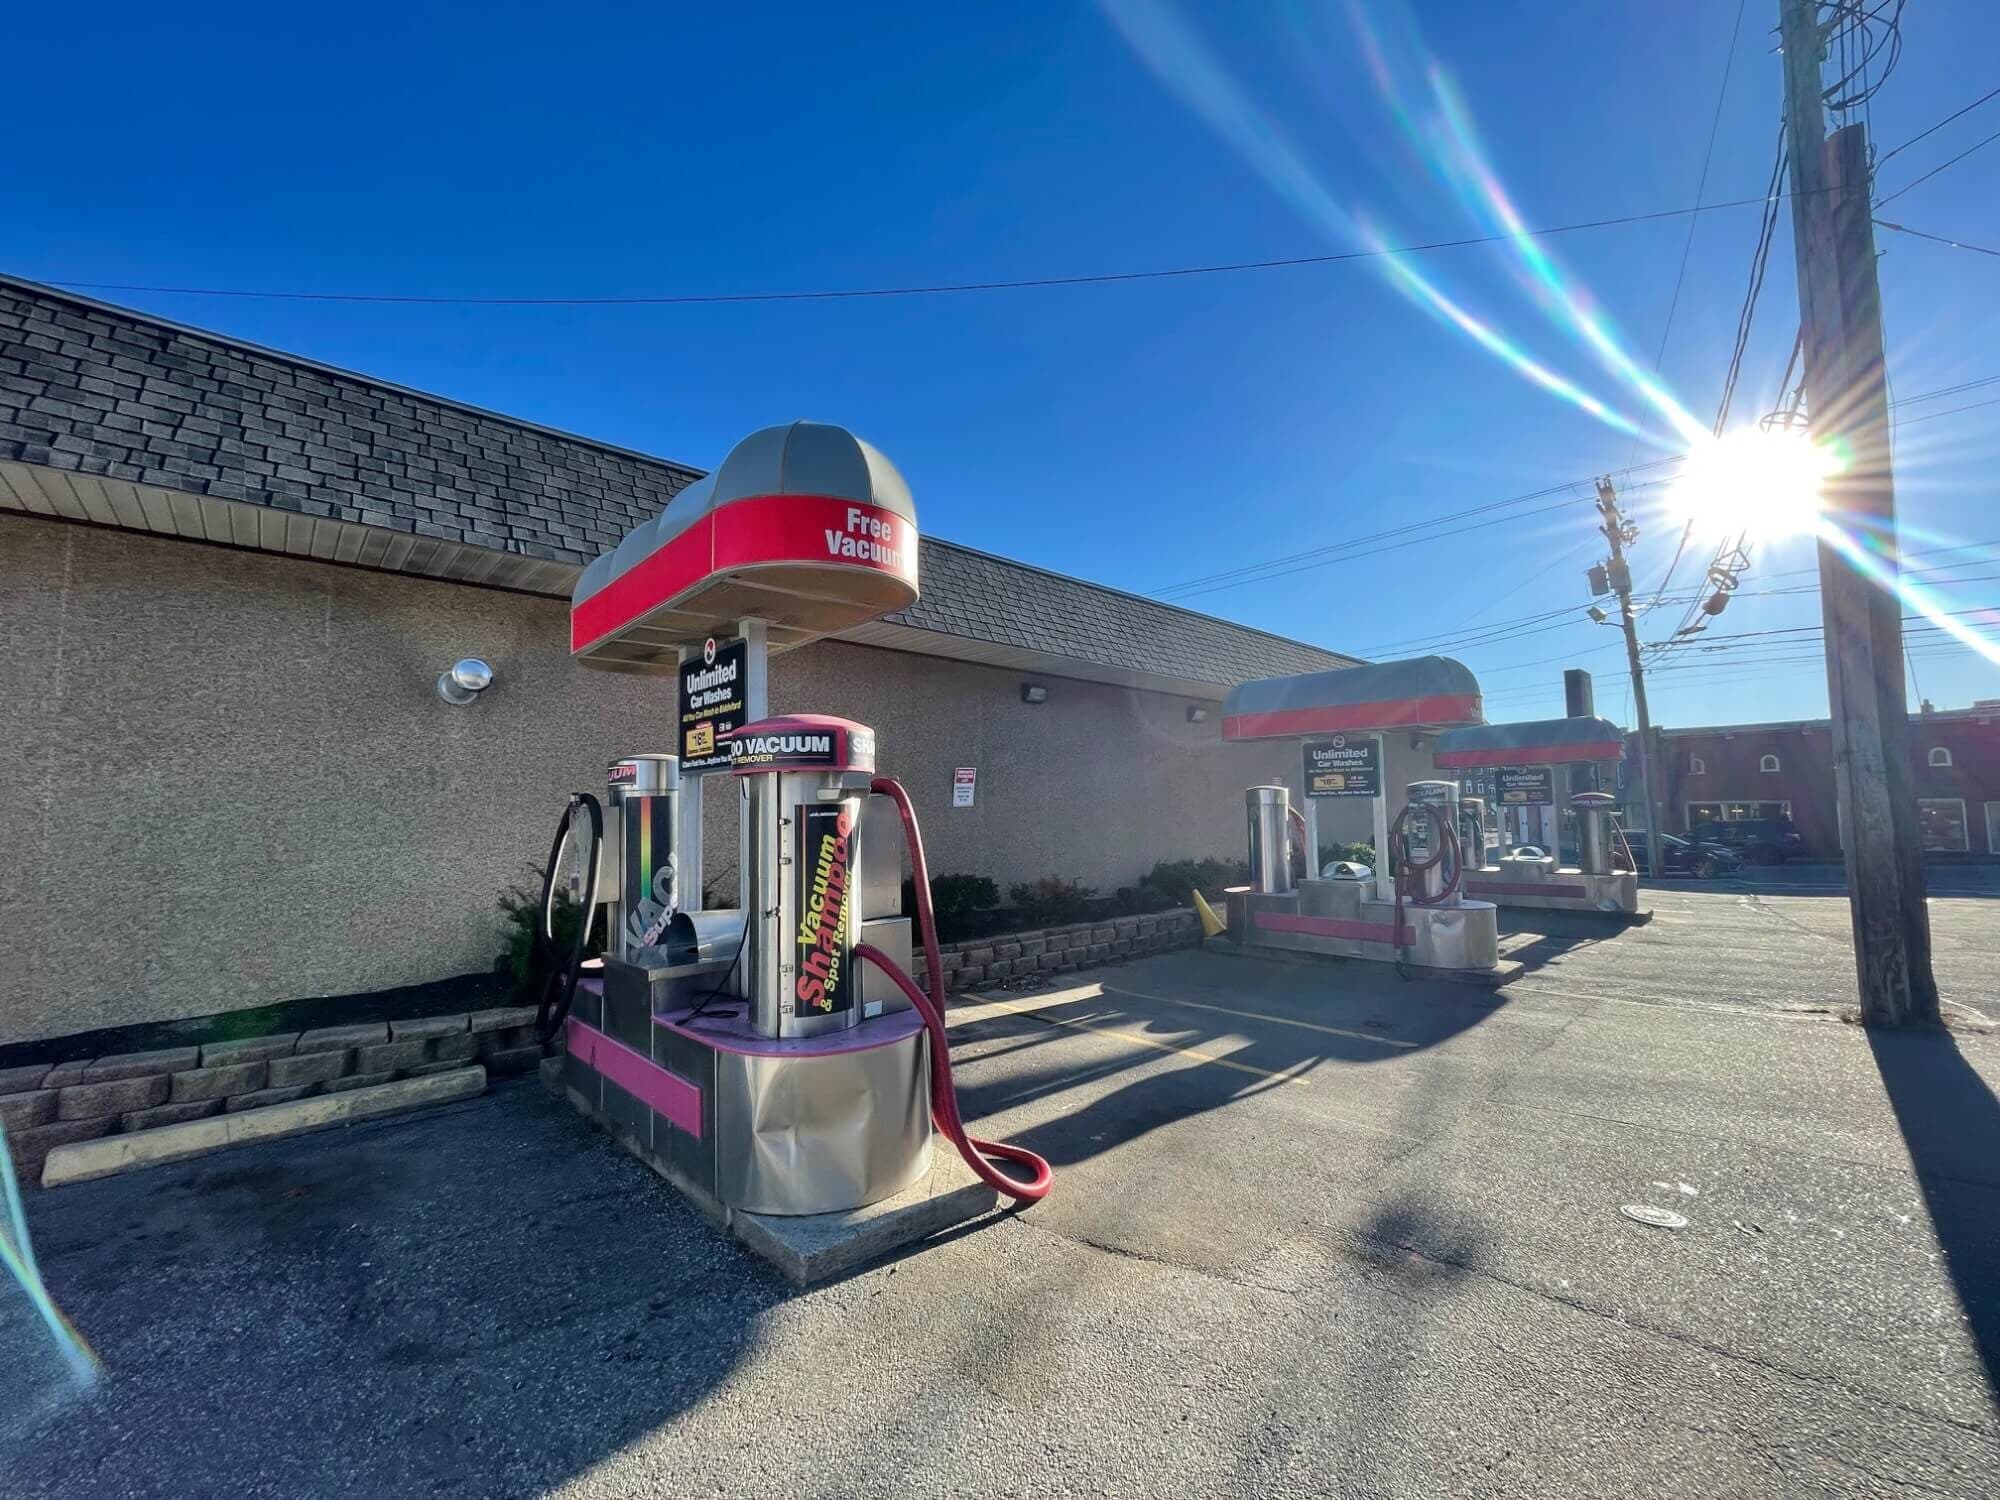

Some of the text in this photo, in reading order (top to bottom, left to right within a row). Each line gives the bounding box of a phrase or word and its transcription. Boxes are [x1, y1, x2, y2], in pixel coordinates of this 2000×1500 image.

[847, 507, 892, 542] Free
[686, 658, 737, 694] Unlimited
[690, 687, 732, 709] Car Washes
[737, 754, 774, 764] REMOVER
[745, 735, 830, 755] VACUUM
[1312, 747, 1368, 760] Unlimited
[797, 834, 836, 944] Vacuum
[796, 814, 852, 1007] Shampoo
[820, 869, 852, 1012] & Spot Remover
